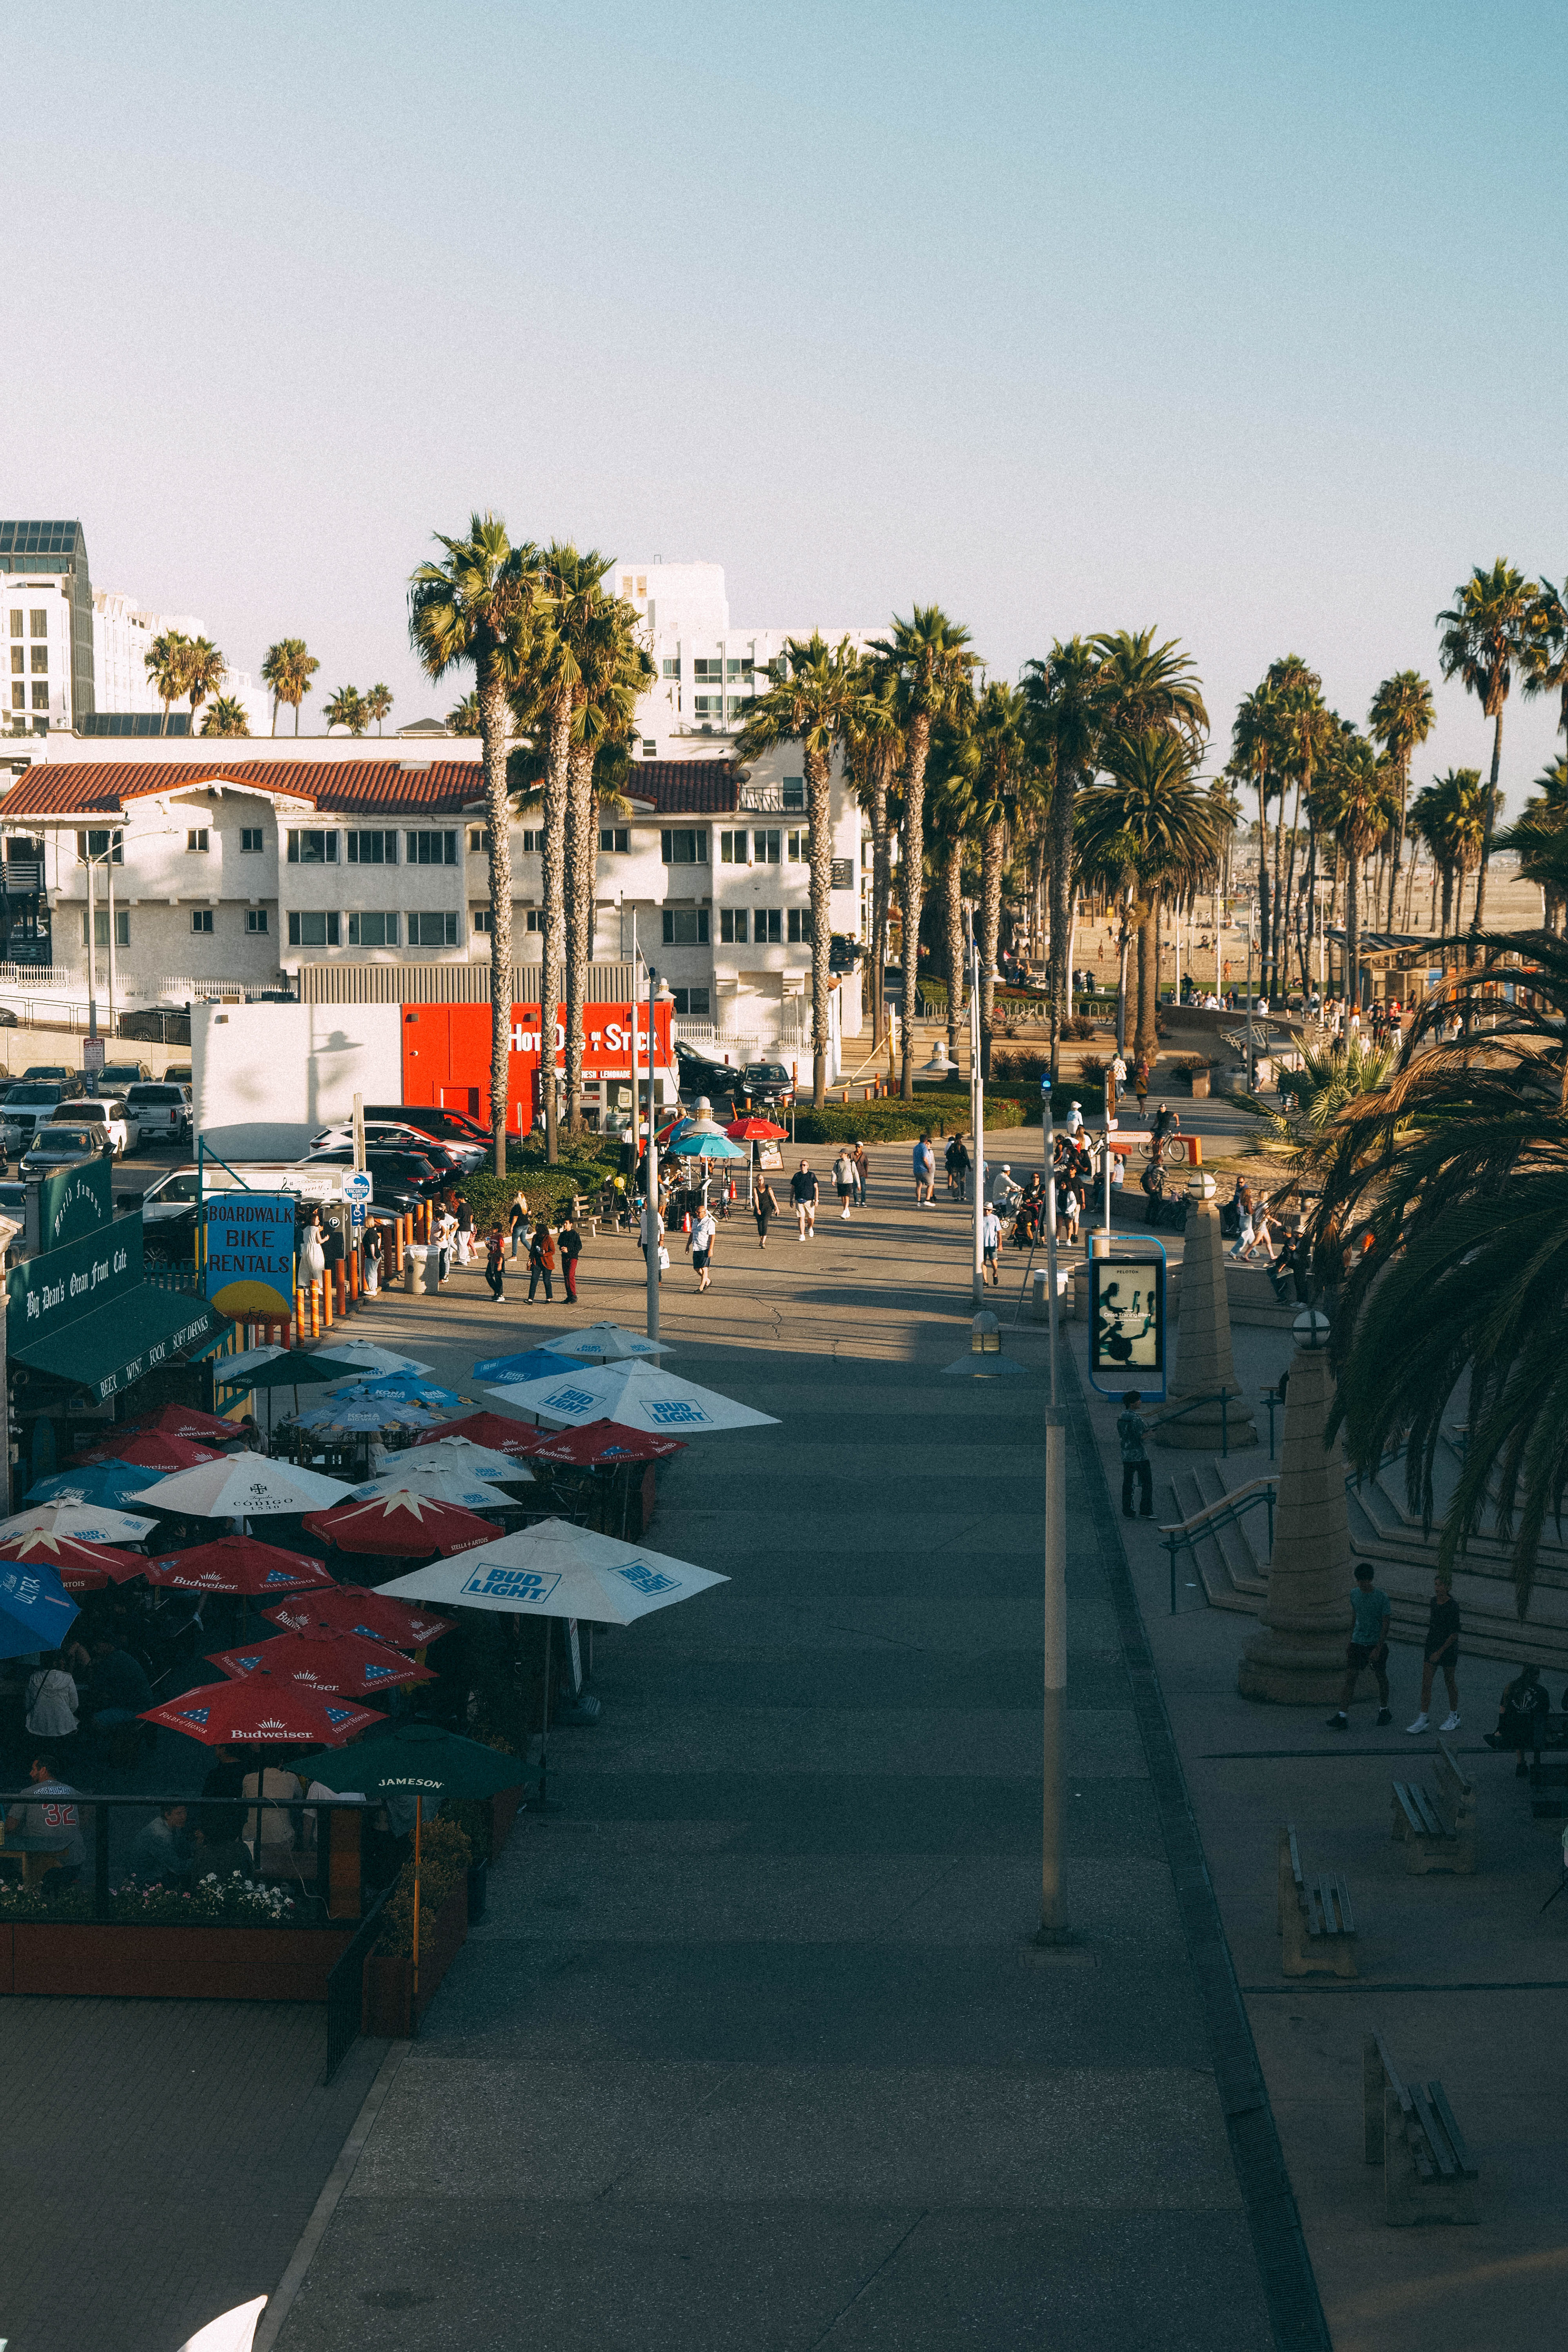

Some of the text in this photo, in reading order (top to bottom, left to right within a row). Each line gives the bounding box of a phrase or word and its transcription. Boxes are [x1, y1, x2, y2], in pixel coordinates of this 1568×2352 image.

[591, 1031, 601, 1041] ON
[605, 1023, 658, 1051] STCK
[594, 1042, 599, 1051] A
[55, 1187, 72, 1236] World
[209, 1206, 294, 1223] BOARDWALK
[226, 1229, 275, 1247] BIKE
[209, 1254, 289, 1273] RENTALS
[27, 1290, 40, 1321] Big
[42, 1278, 65, 1312] Dean's
[70, 1272, 88, 1297] Ocean
[114, 1248, 127, 1273] Cafe
[173, 1328, 187, 1350] SOFT
[543, 1396, 589, 1414] LIGHT
[561, 1389, 594, 1405] BUD
[652, 1402, 691, 1413] BUD
[652, 1411, 704, 1423] LIGHT
[535, 1448, 577, 1461] Budweiser
[451, 1537, 488, 1551] STELLA ARTOIS
[487, 1568, 542, 1586] BUD
[619, 1566, 652, 1581] BUD
[13, 1576, 41, 1604] ULTRA
[172, 1576, 238, 1590] Budweiser
[468, 1579, 546, 1600] LIGHT
[631, 1573, 674, 1593] LIGHT
[412, 1622, 445, 1641] Budweiser
[222, 1655, 234, 1667] FOLDS
[361, 1680, 383, 1688] FOLDS
[389, 1671, 415, 1682] HONOR
[159, 1711, 180, 1724] FOLDS
[185, 1721, 207, 1734] HONOR
[332, 1723, 347, 1734] FOLDS
[350, 1713, 370, 1724] HONOR
[231, 1730, 313, 1739] Budweiser
[378, 1778, 443, 1788] JAMESON
[42, 1803, 76, 1826] 32
